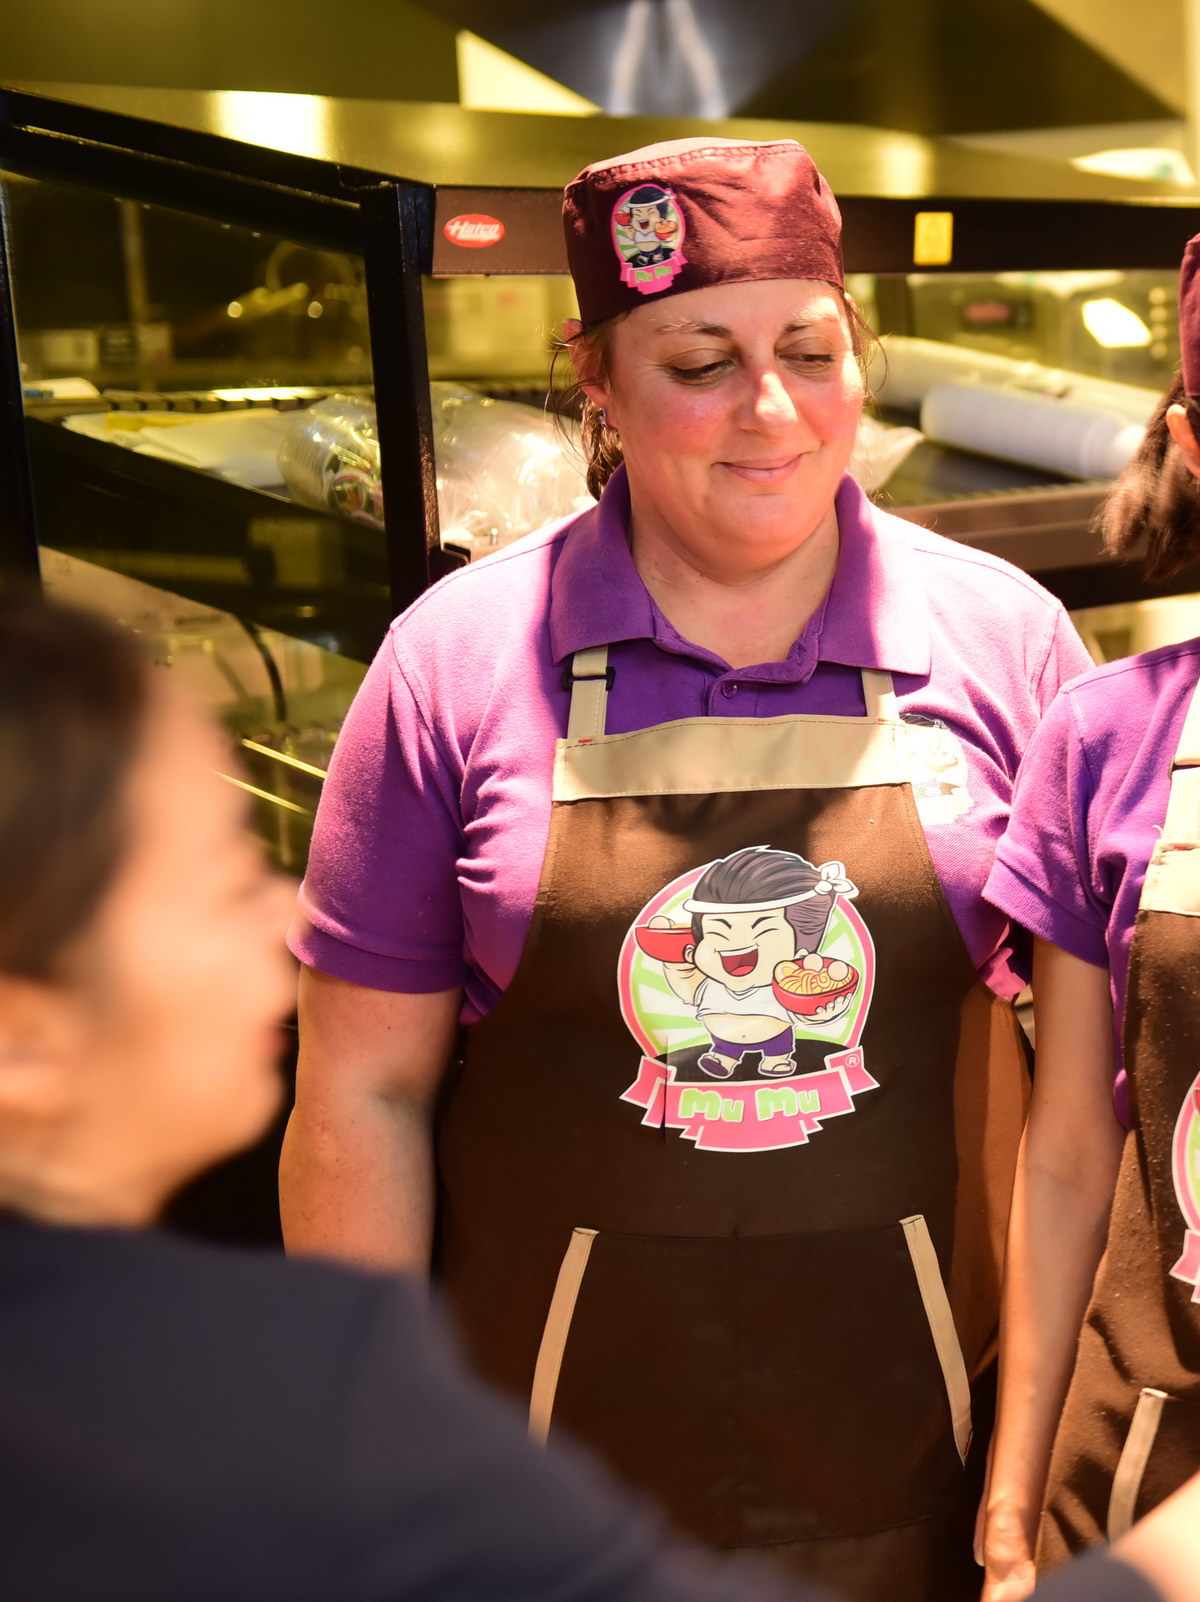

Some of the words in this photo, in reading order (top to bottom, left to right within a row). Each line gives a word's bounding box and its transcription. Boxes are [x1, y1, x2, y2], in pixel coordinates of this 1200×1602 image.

[448, 221, 500, 239] Hatco
[678, 1087, 744, 1122] Mu
[754, 1087, 821, 1121] Mu
